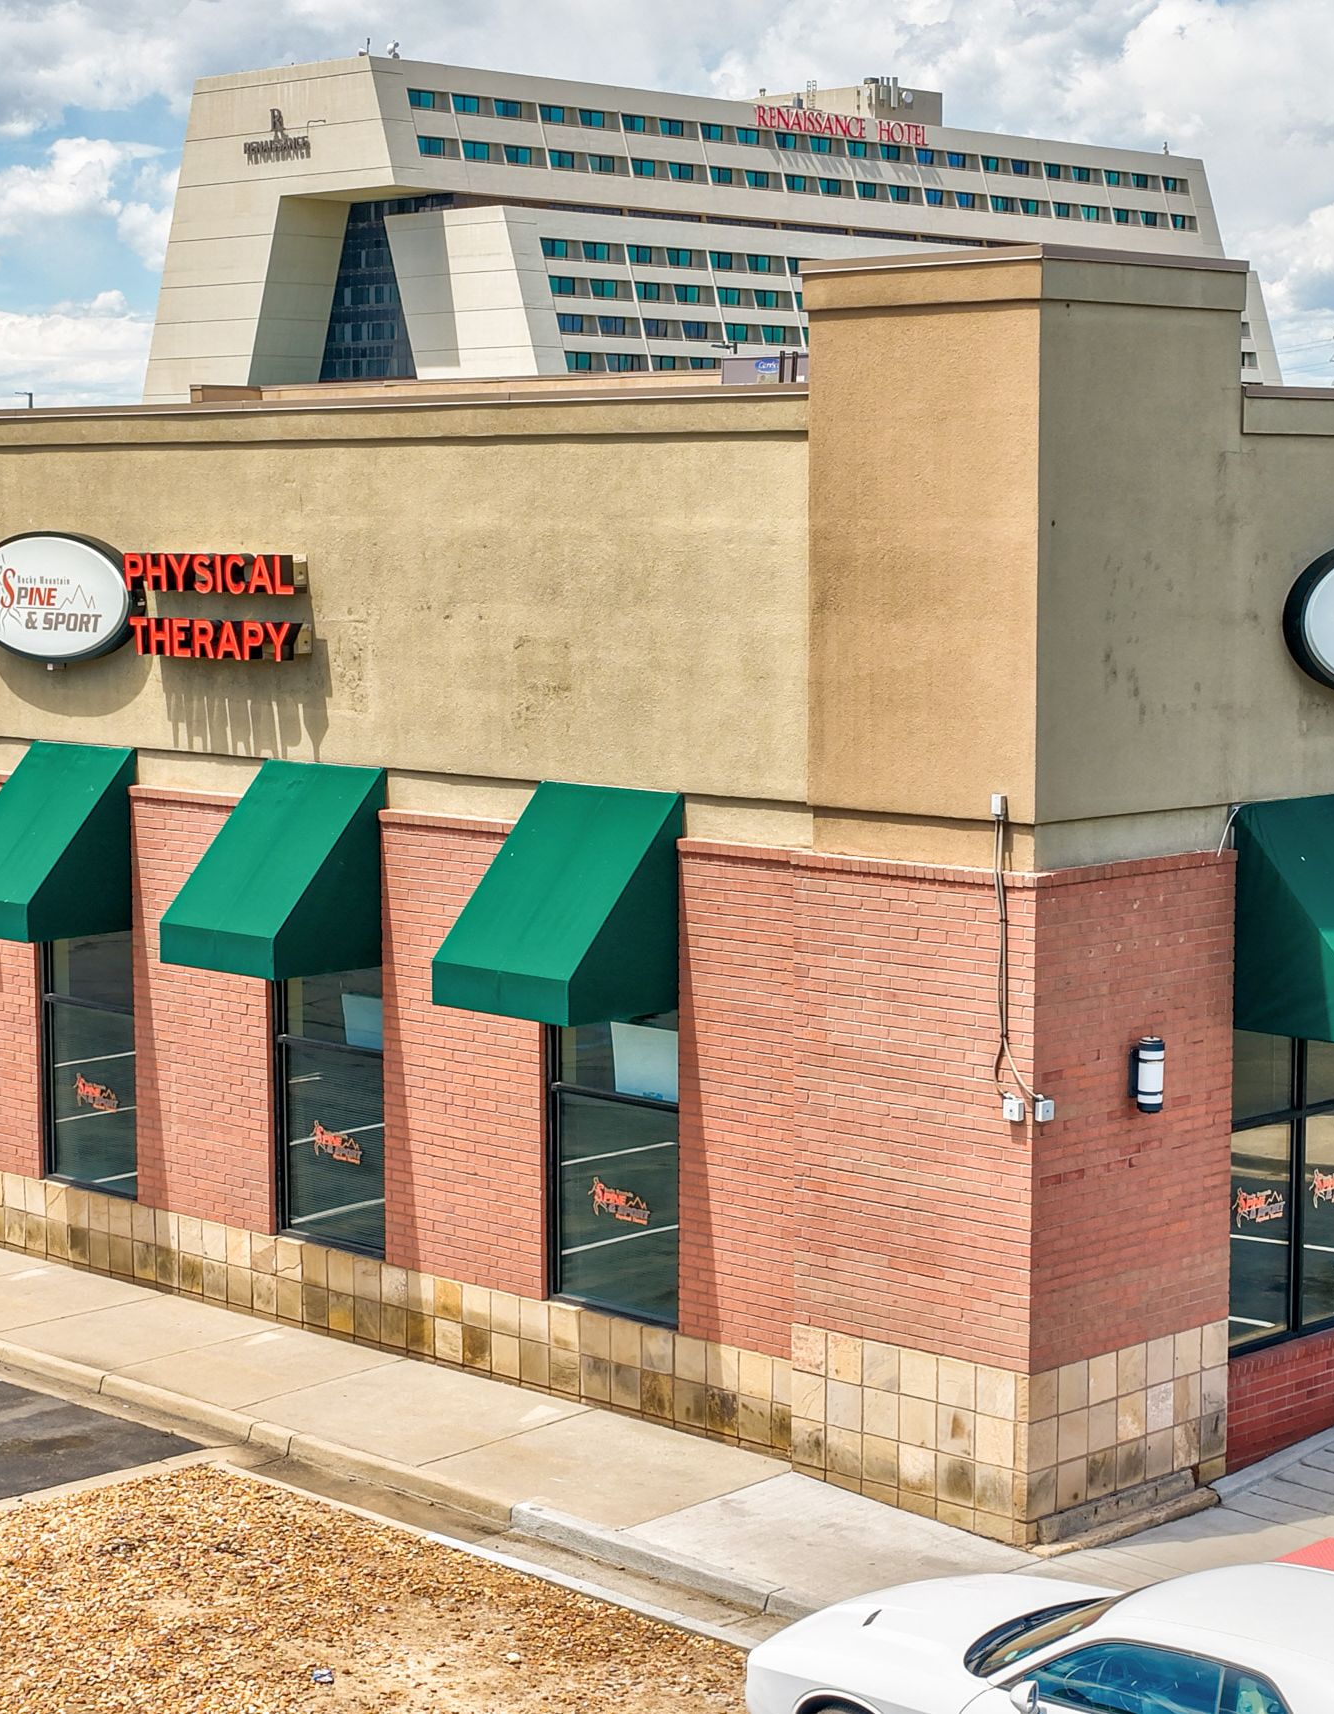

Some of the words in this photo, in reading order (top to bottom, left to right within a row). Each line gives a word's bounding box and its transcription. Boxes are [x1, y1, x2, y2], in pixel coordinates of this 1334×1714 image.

[243, 136, 310, 155] RENAISSANCE
[755, 105, 867, 140] RENAISSANCE
[875, 120, 929, 146] HOTEL
[0, 567, 58, 609] SPINE
[17, 574, 37, 586] Rocky
[39, 575, 71, 586] Mountain
[124, 553, 295, 595] PHYSICAL
[25, 611, 38, 630] &
[42, 612, 103, 633] SPORT
[129, 617, 291, 662] THERAPY
